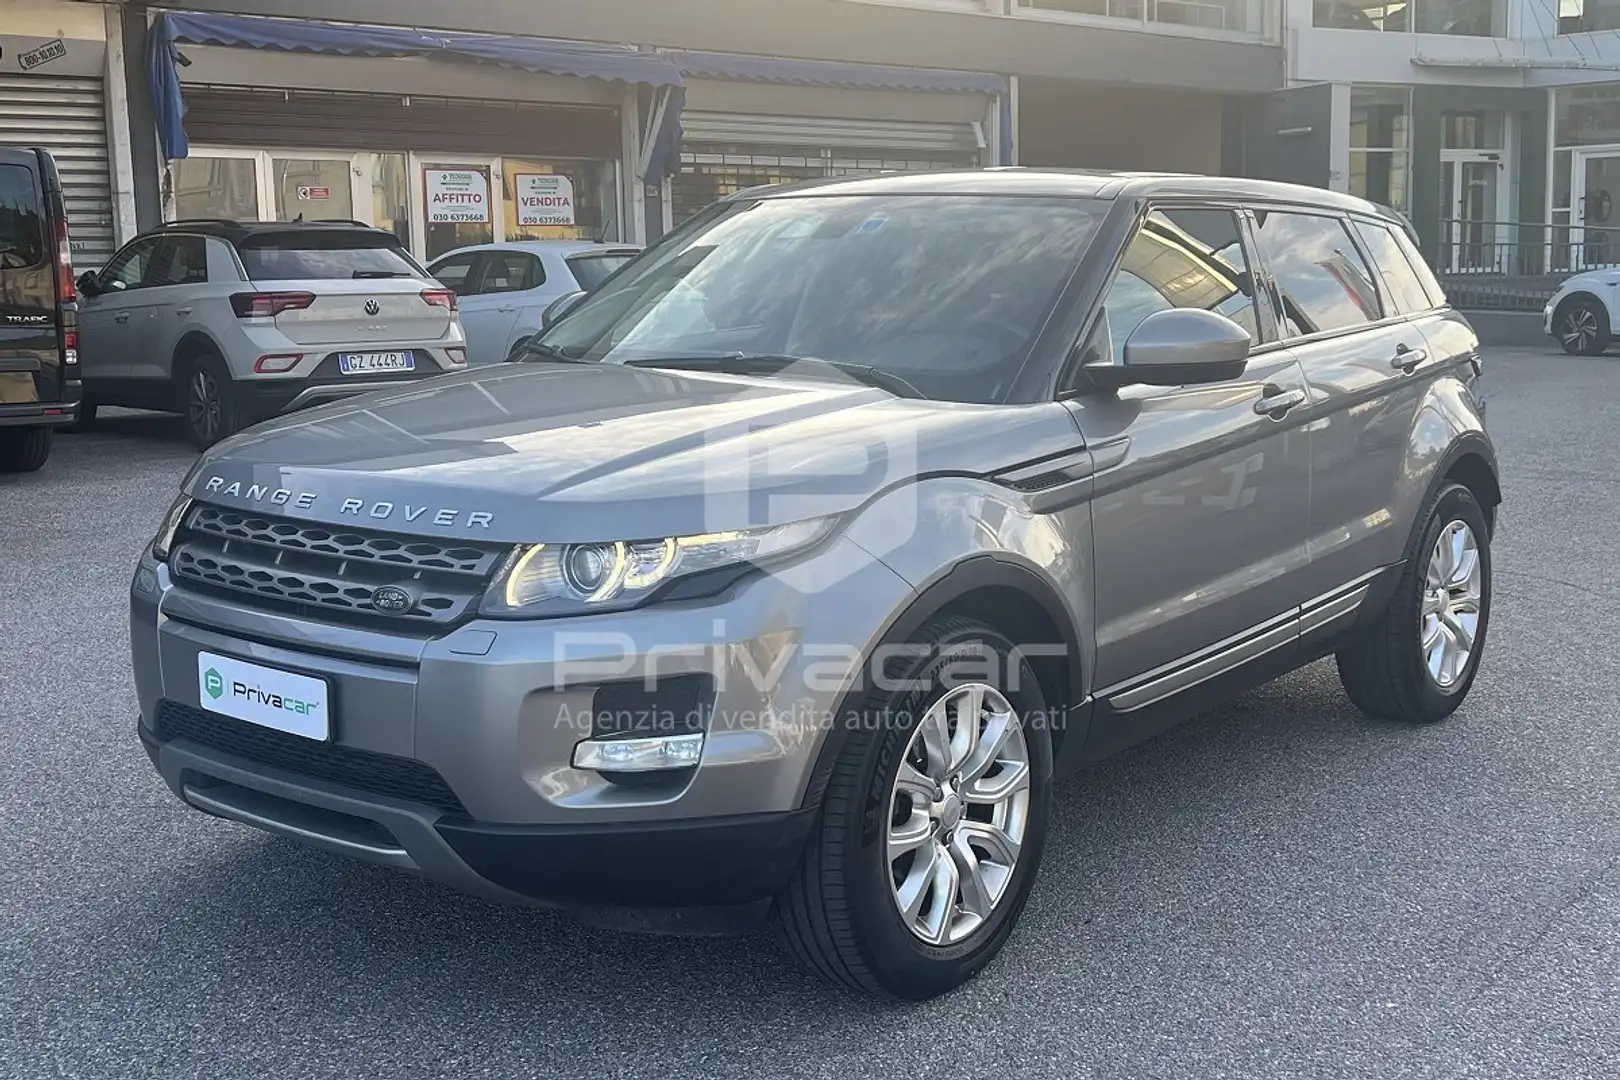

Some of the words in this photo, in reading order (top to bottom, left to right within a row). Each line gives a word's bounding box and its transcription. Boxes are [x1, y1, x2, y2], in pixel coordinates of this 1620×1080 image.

[433, 192, 482, 204] AFFITTO
[521, 196, 571, 207] VENDITA
[433, 213, 449, 221] 030
[522, 216, 538, 224] 030
[349, 355, 365, 370] GZ
[368, 352, 405, 368] 444RJ
[204, 475, 317, 510] RANGE
[340, 497, 494, 529] ROVER
[232, 681, 317, 716] Privacar
